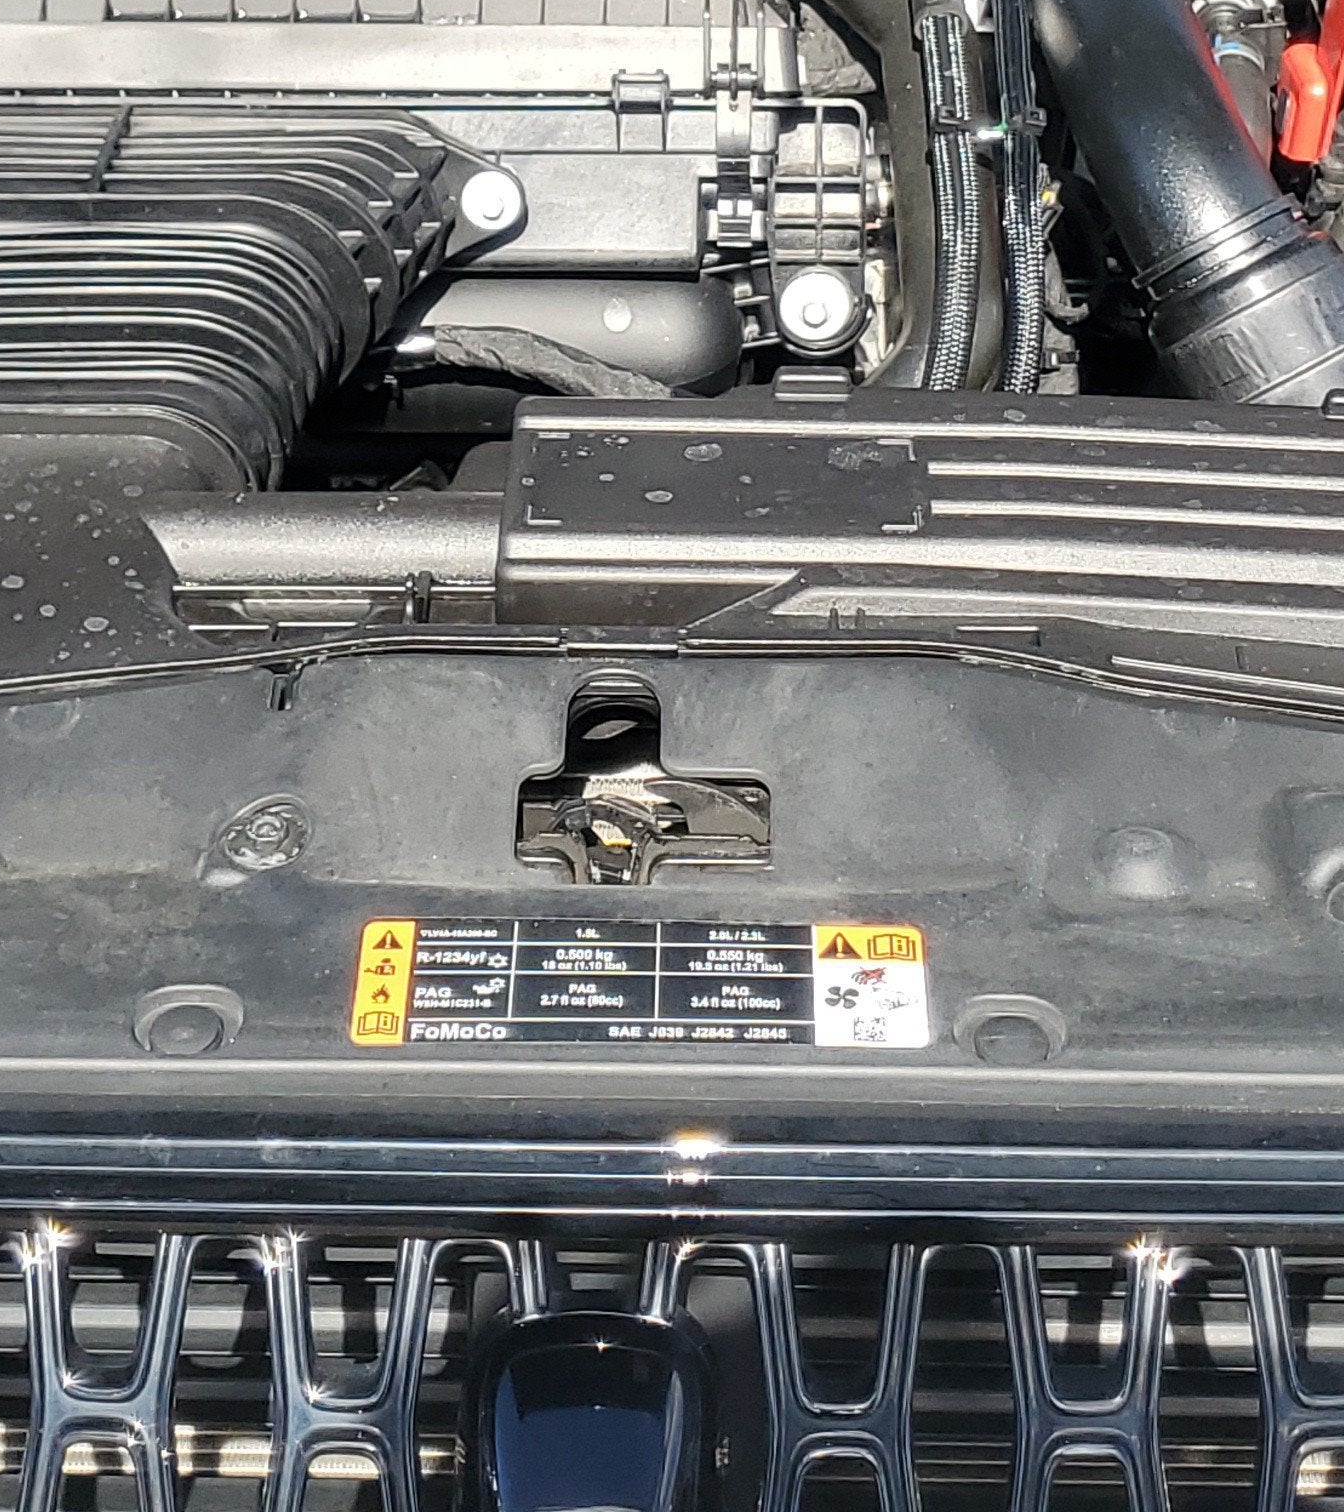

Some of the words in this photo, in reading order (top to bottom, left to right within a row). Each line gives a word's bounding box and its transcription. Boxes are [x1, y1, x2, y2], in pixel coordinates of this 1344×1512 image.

[416, 951, 487, 966] R-1234yf
[595, 949, 614, 963] kg
[746, 949, 765, 963] kg
[414, 987, 453, 999] PAG
[568, 983, 598, 994] PAG
[721, 985, 750, 996] PAG
[540, 994, 559, 1006] 2.7
[570, 996, 586, 1006] oz
[720, 998, 736, 1008] oz
[410, 1022, 507, 1041] FoMoCo
[608, 1026, 642, 1038] SAE
